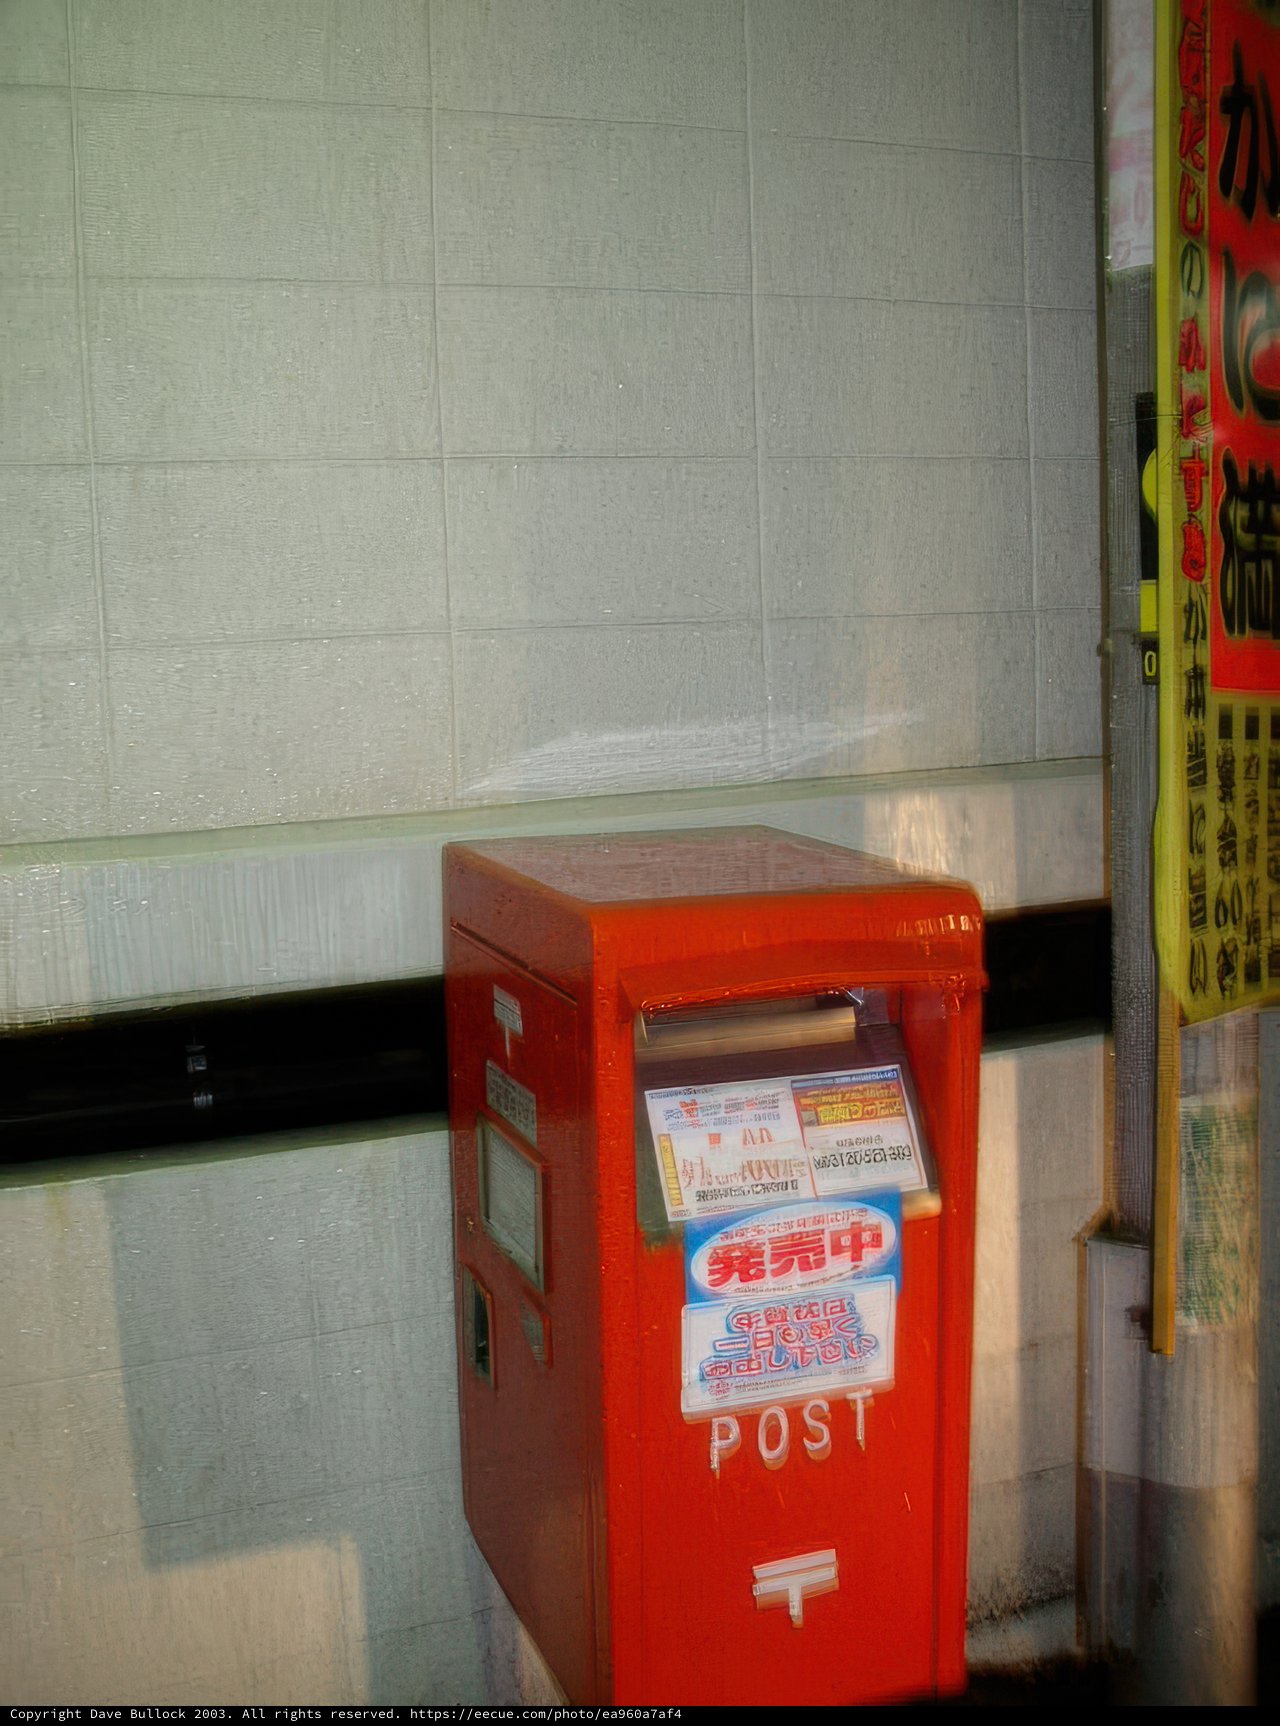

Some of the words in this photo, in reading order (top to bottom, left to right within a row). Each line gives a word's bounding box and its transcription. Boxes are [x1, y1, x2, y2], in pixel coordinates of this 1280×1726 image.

[707, 1220, 883, 1288] 発売中
[710, 1388, 873, 1477] POST
